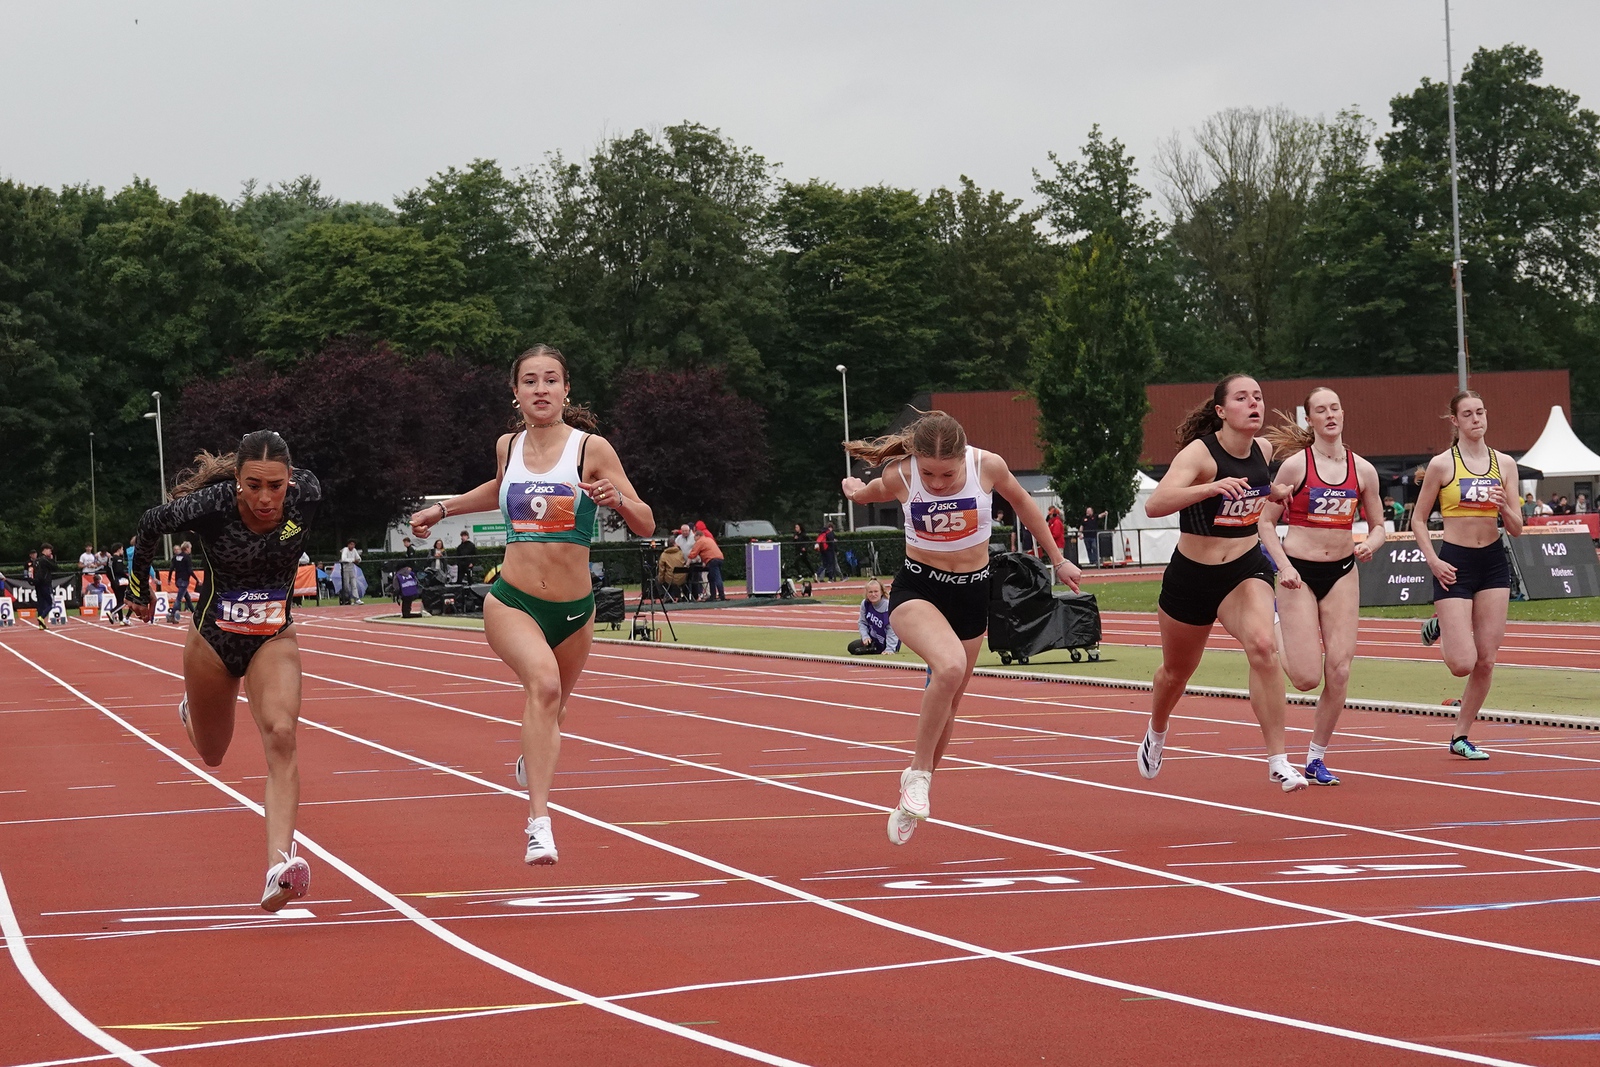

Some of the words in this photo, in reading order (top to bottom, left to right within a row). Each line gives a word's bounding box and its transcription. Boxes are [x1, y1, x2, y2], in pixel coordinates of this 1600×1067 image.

[530, 496, 548, 520] 9
[937, 502, 958, 511] asics
[1221, 497, 1267, 517] 1030
[1313, 497, 1352, 516] 224
[922, 512, 967, 533] 125
[280, 526, 302, 540] adidas
[1541, 543, 1567, 556] 14:29
[928, 570, 969, 585] NIKE
[970, 565, 990, 584] PR
[1387, 574, 1425, 584] Atleten:
[1551, 567, 1574, 577] Atleten:
[1400, 587, 1410, 601] 5
[1563, 581, 1572, 594] 5
[247, 592, 270, 600] asics
[0, 602, 10, 618] 6
[103, 598, 114, 614] 4
[156, 597, 166, 612] 3
[222, 600, 283, 625] 1032
[1278, 864, 1467, 875] 4
[883, 876, 1081, 889] 5
[506, 892, 701, 906] 6
